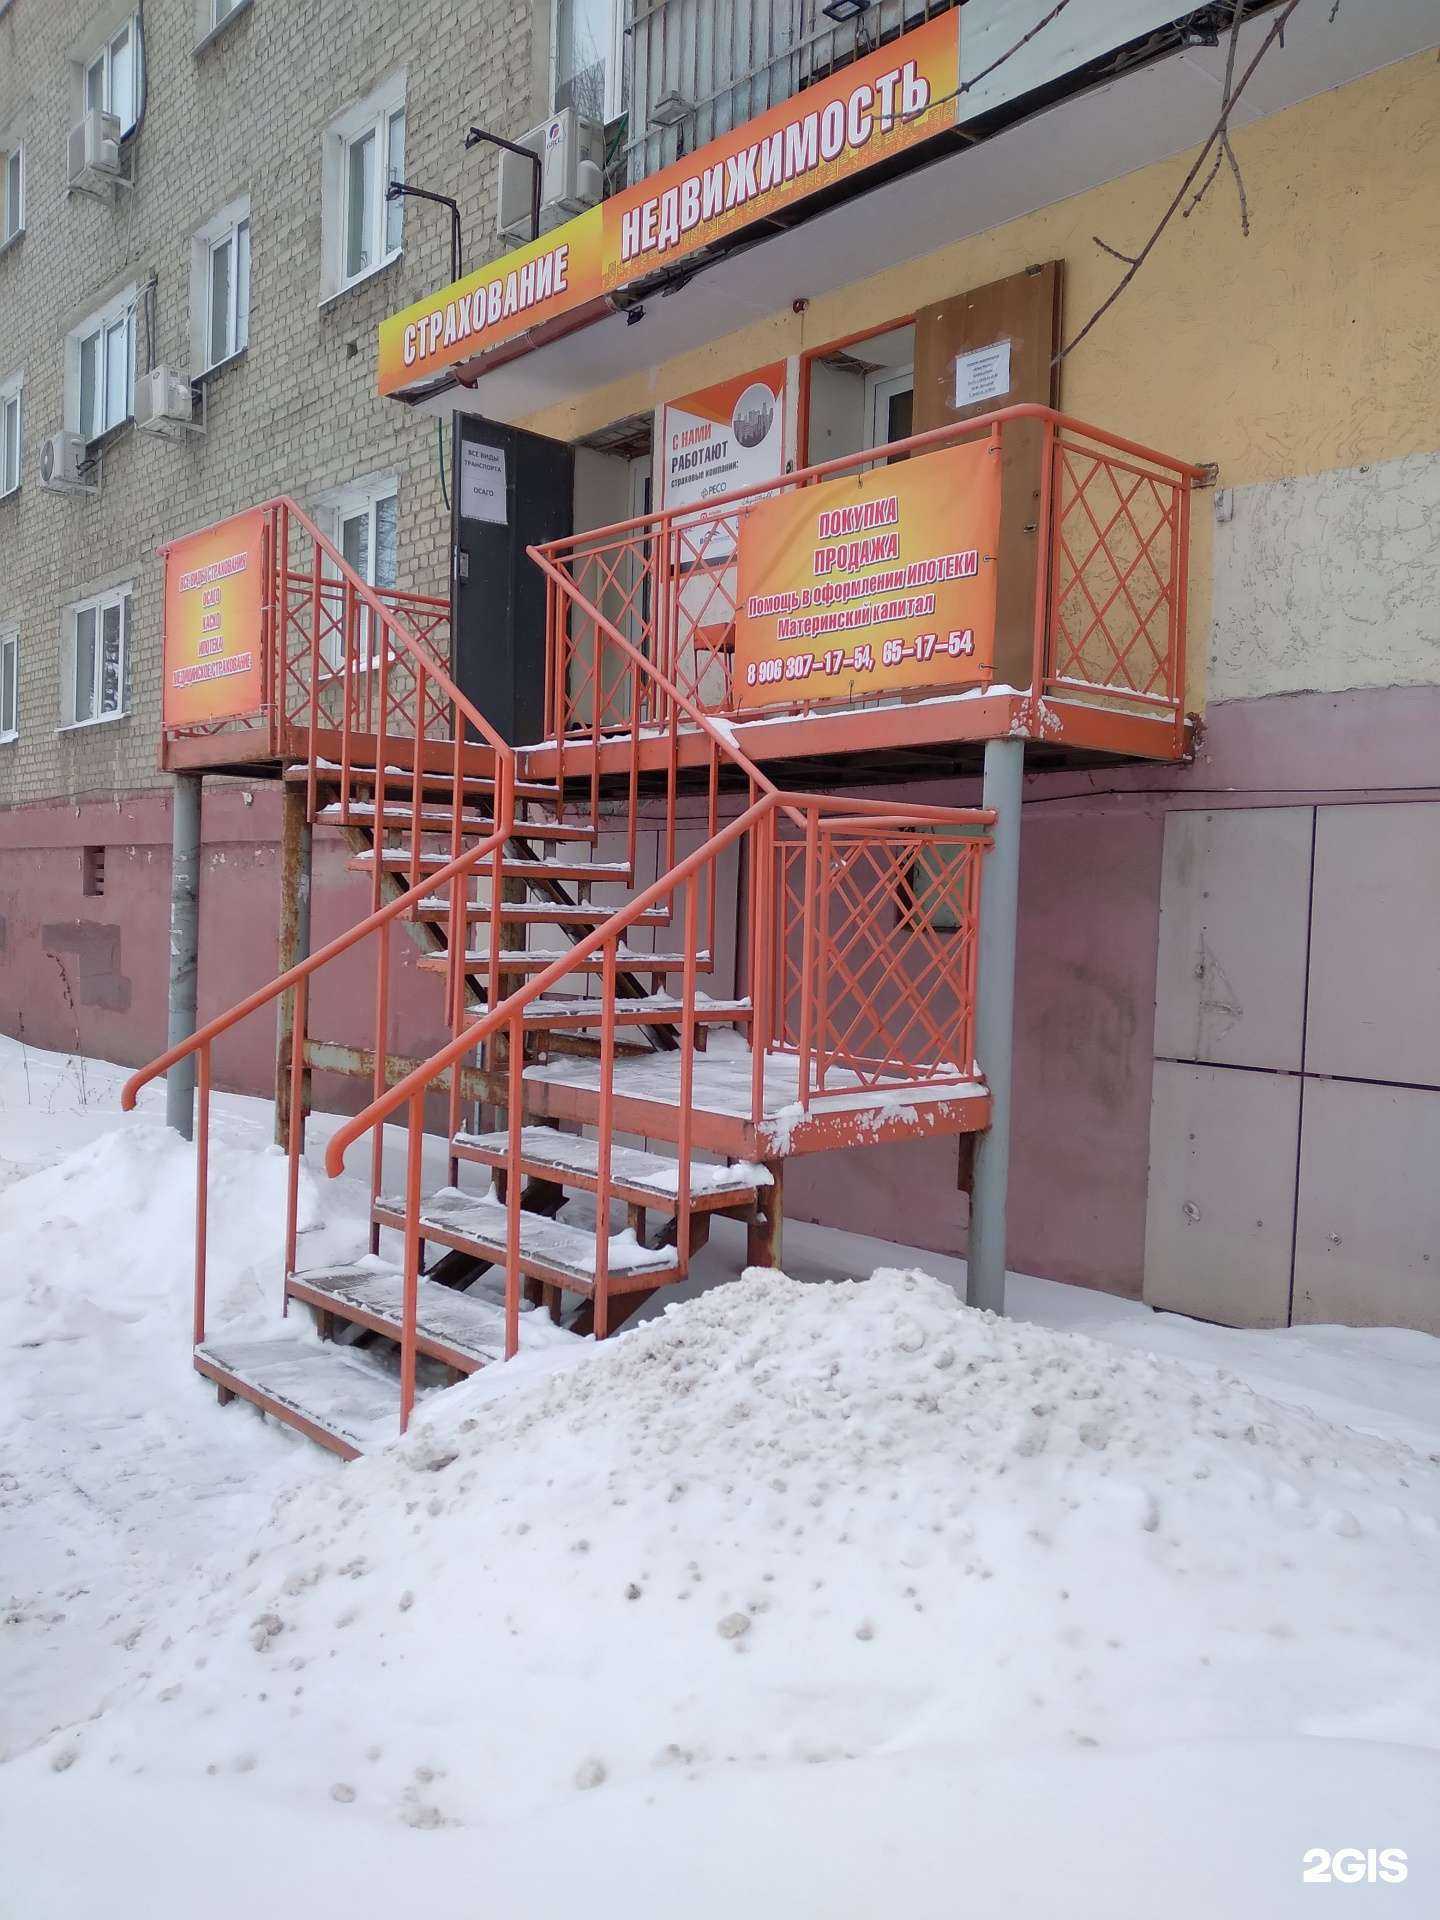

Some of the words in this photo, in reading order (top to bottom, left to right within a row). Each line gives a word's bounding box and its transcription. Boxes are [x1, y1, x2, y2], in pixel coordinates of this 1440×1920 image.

[621, 60, 931, 263] НЕДВИЖИМОСТЬ
[402, 243, 569, 367] СТРАХОВАНИЕ
[681, 423, 712, 448] НАМИ
[464, 459, 502, 473] ТРАНСПОРТА
[468, 449, 479, 458] ВСЕ
[671, 440, 729, 474] РАБОТАЮТ
[473, 486, 494, 497] ОСАГО
[671, 470, 705, 489] страховые
[819, 495, 899, 540] ПОКУПКА
[814, 532, 899, 576] ПРОДАЖА
[748, 593, 799, 619] Помощь
[801, 589, 812, 608] в
[813, 569, 906, 607] оформлении
[905, 550, 979, 587] ИПОТЕКИ
[777, 600, 872, 640] Материнский
[871, 593, 936, 624] капитал
[747, 661, 758, 686] 8
[757, 658, 785, 683] 906
